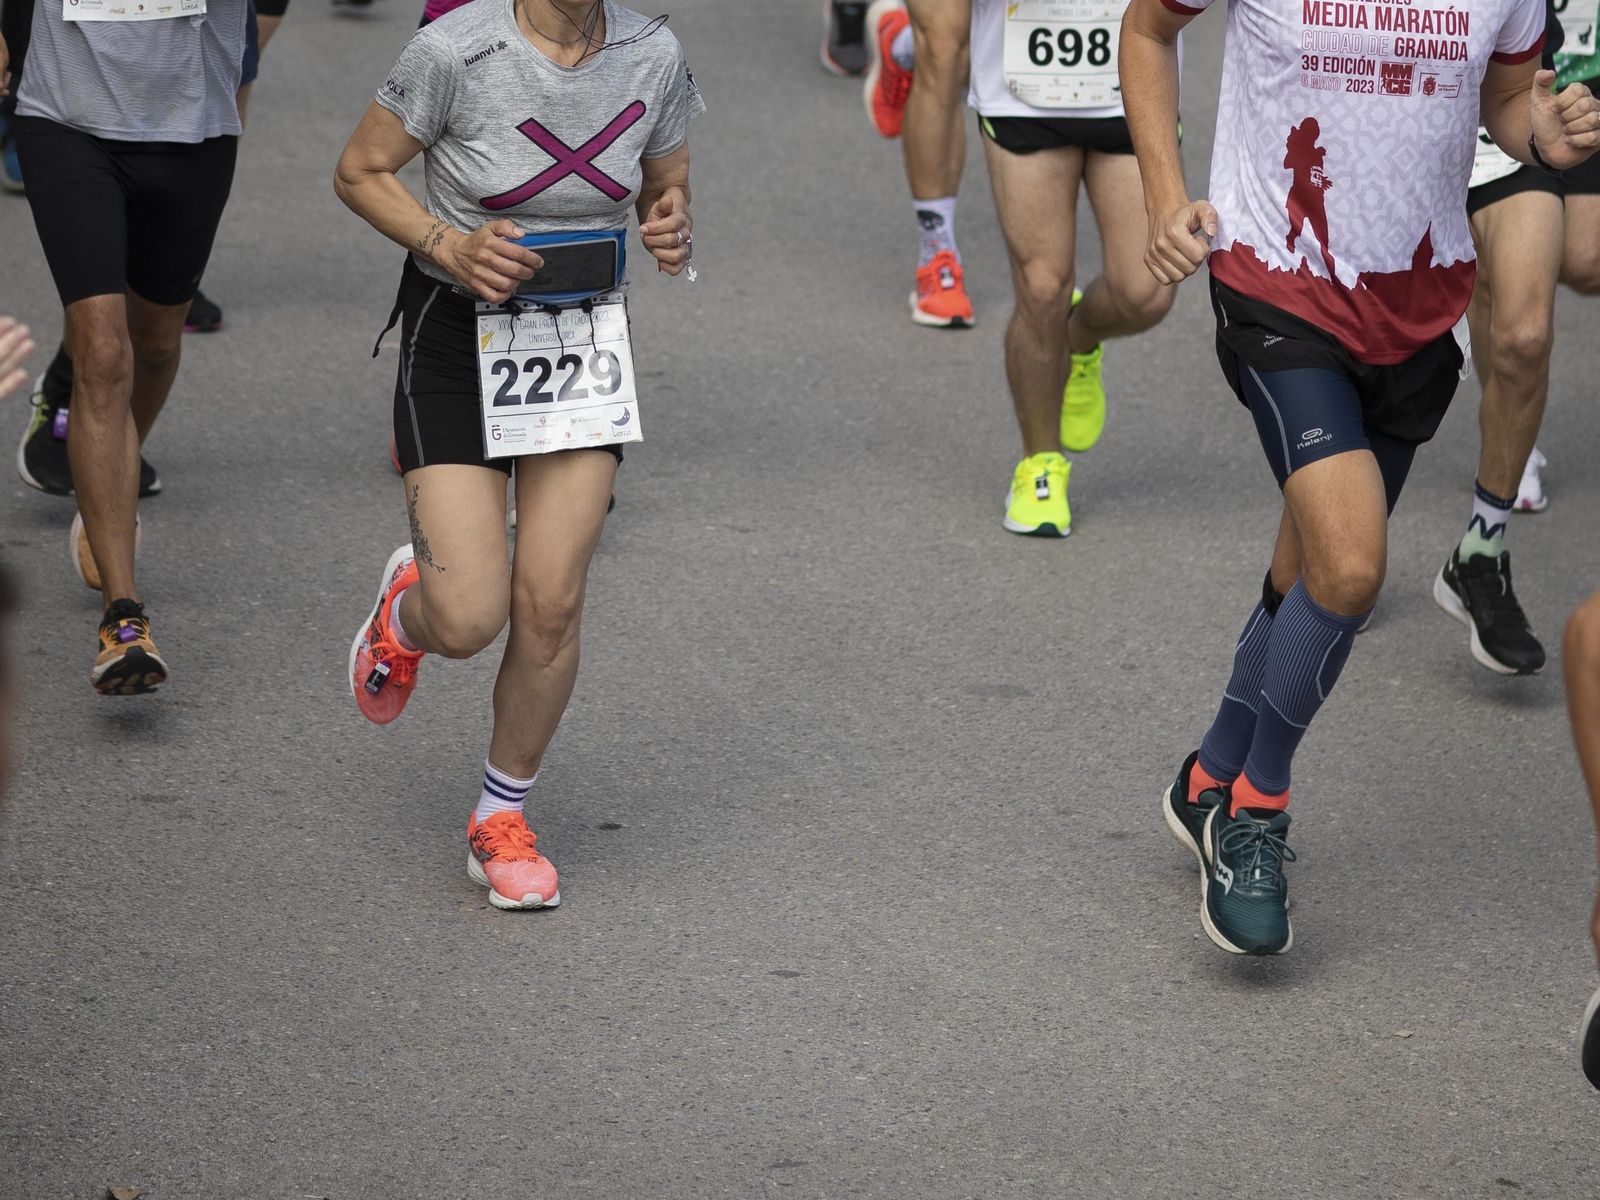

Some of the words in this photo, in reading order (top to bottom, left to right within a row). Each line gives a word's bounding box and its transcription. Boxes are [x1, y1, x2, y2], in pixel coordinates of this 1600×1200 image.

[1302, 0, 1368, 30] MEDIA
[1375, 6, 1470, 37] MARATÓN
[464, 44, 496, 67] luanvi
[1028, 27, 1111, 67] 698
[1301, 30, 1363, 55] CIUDAD
[1367, 34, 1390, 57] DE
[1394, 37, 1469, 62] GRANADA
[1301, 54, 1319, 71] 39
[1323, 55, 1376, 76] EDICIÓN
[1301, 73, 1309, 87] 6
[1310, 74, 1341, 91] MAYO
[1346, 78, 1375, 94] 2023
[519, 318, 537, 330] GRAN
[562, 317, 569, 326] DE
[558, 330, 576, 341] ORCA
[491, 349, 622, 408] 2229
[1297, 433, 1333, 450] Kalenji
